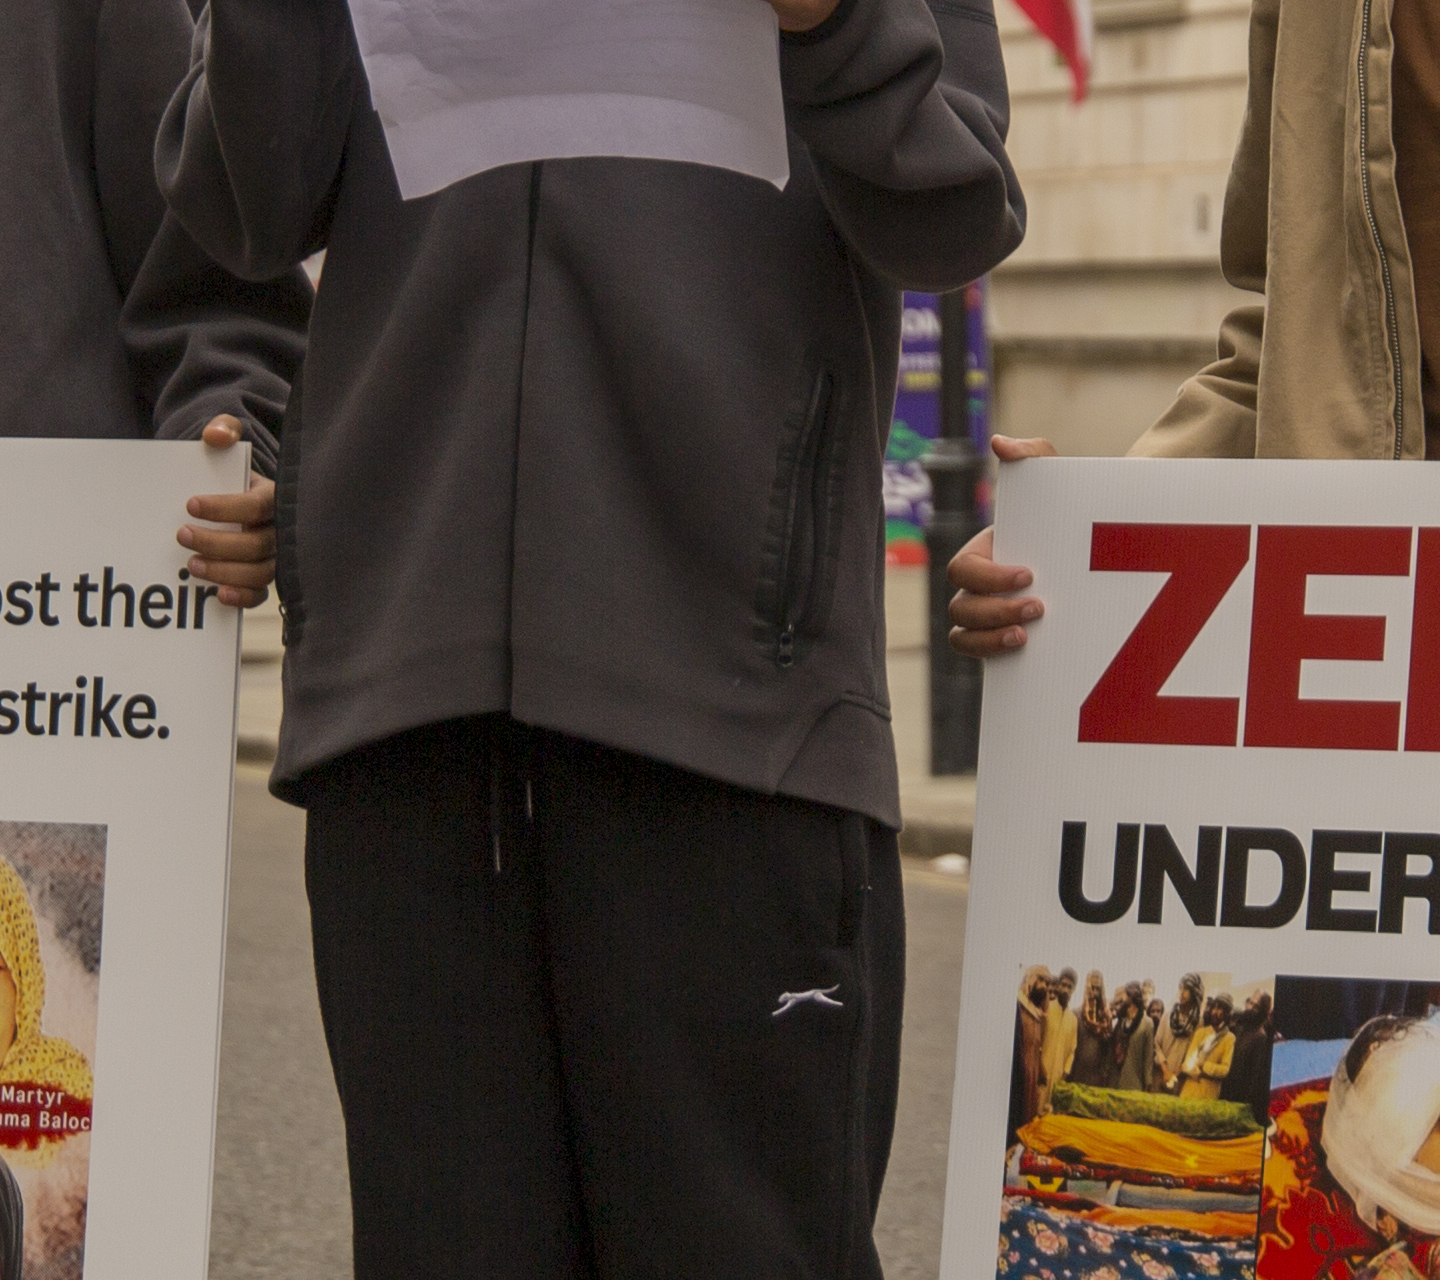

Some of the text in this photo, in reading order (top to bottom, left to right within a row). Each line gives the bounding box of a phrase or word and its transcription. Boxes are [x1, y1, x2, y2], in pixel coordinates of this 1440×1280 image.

[73, 566, 219, 630] their
[1, 1086, 65, 1106] Martyr
[39, 1112, 91, 1130] Baloc
